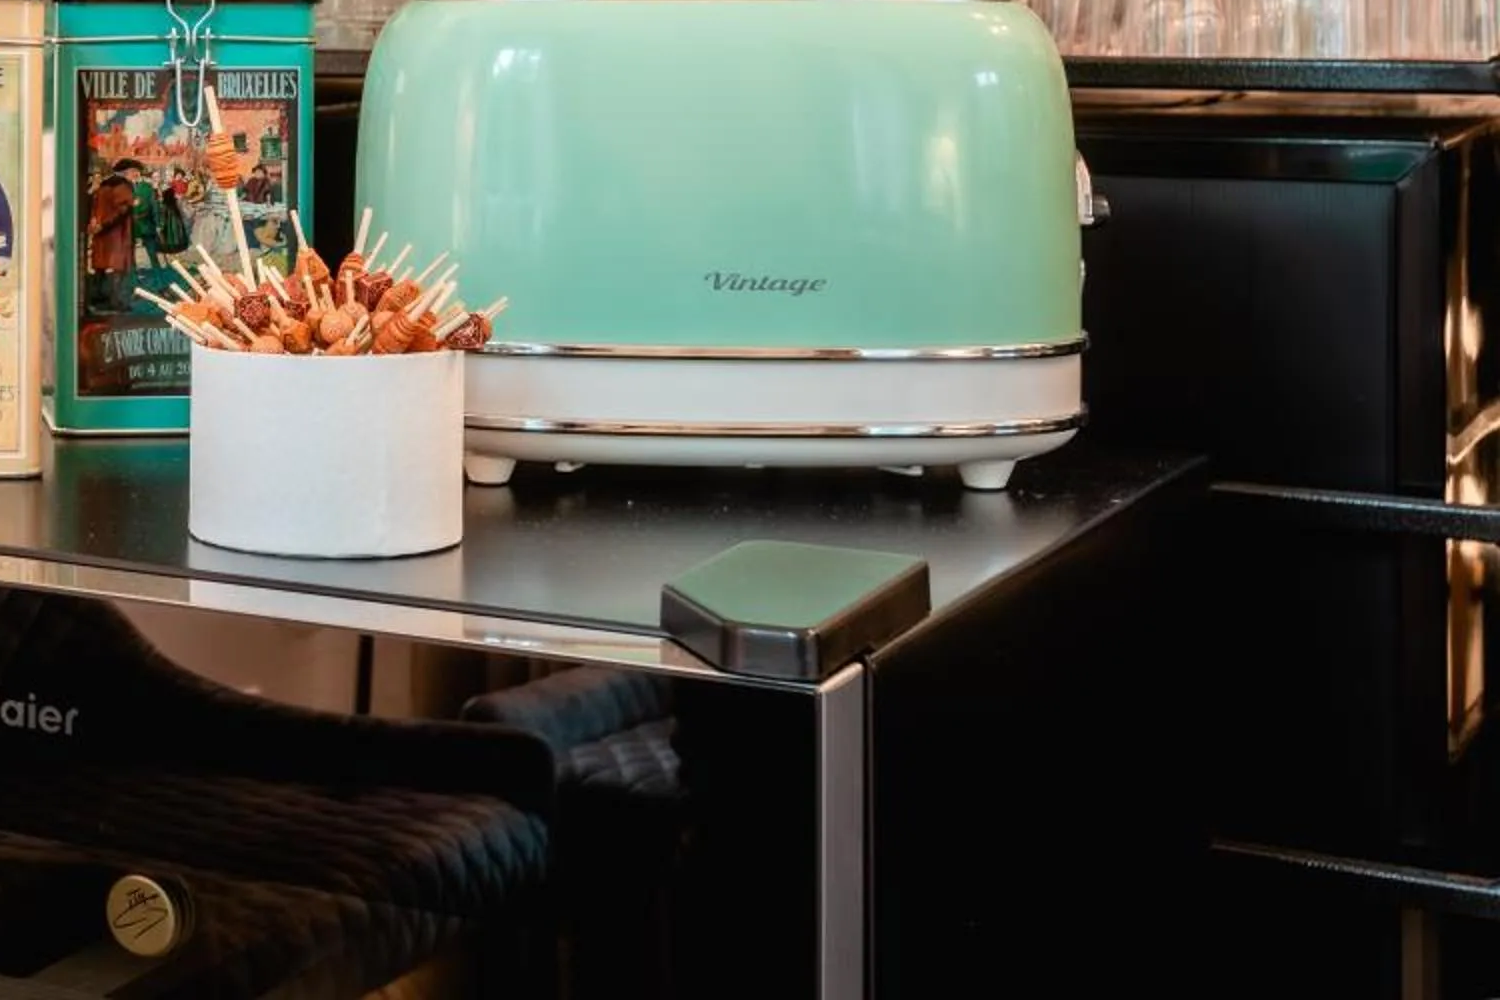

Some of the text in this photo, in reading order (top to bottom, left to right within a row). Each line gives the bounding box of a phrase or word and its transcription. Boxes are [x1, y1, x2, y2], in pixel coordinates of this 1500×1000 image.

[79, 71, 156, 99] VILLE DE
[217, 71, 298, 99] BRUXELLES
[703, 271, 828, 297] Vintage
